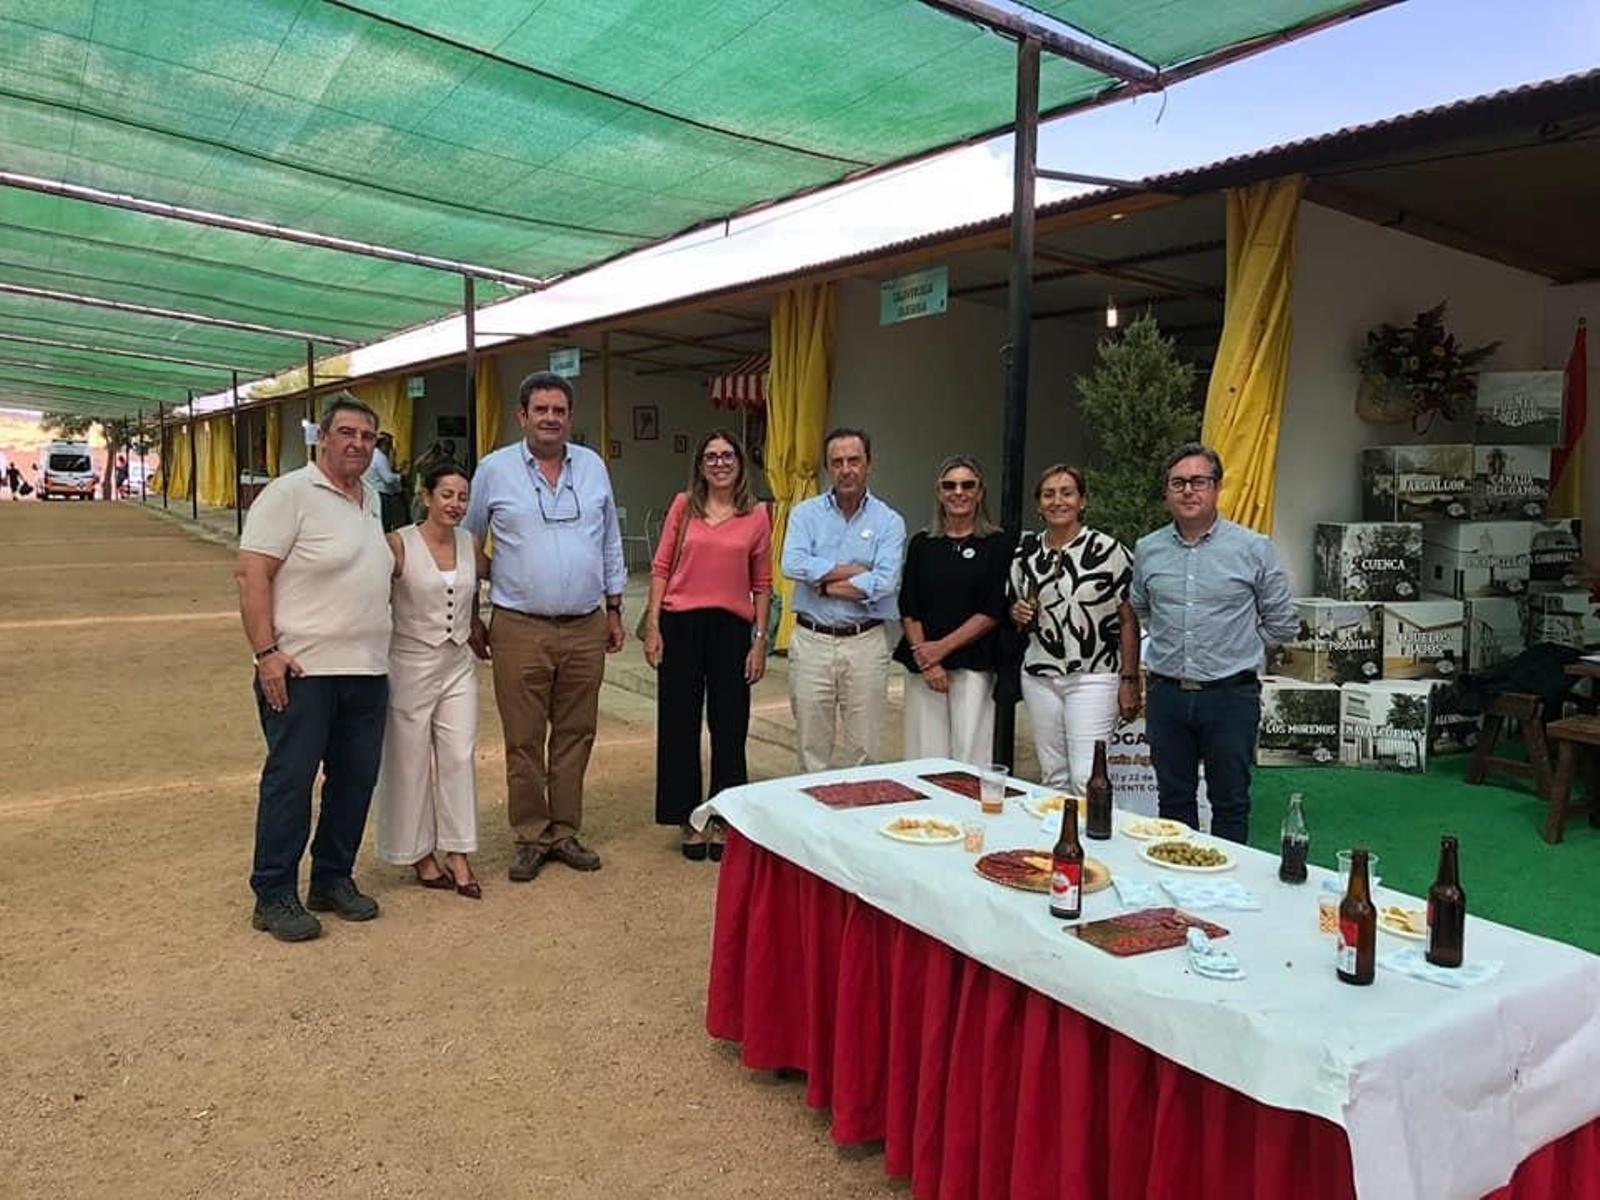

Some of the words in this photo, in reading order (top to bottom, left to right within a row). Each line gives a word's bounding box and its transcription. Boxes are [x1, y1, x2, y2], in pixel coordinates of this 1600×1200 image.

[1361, 558, 1406, 571] CUENCA
[1265, 721, 1286, 734] LOS
[1287, 723, 1336, 736] MORENOS
